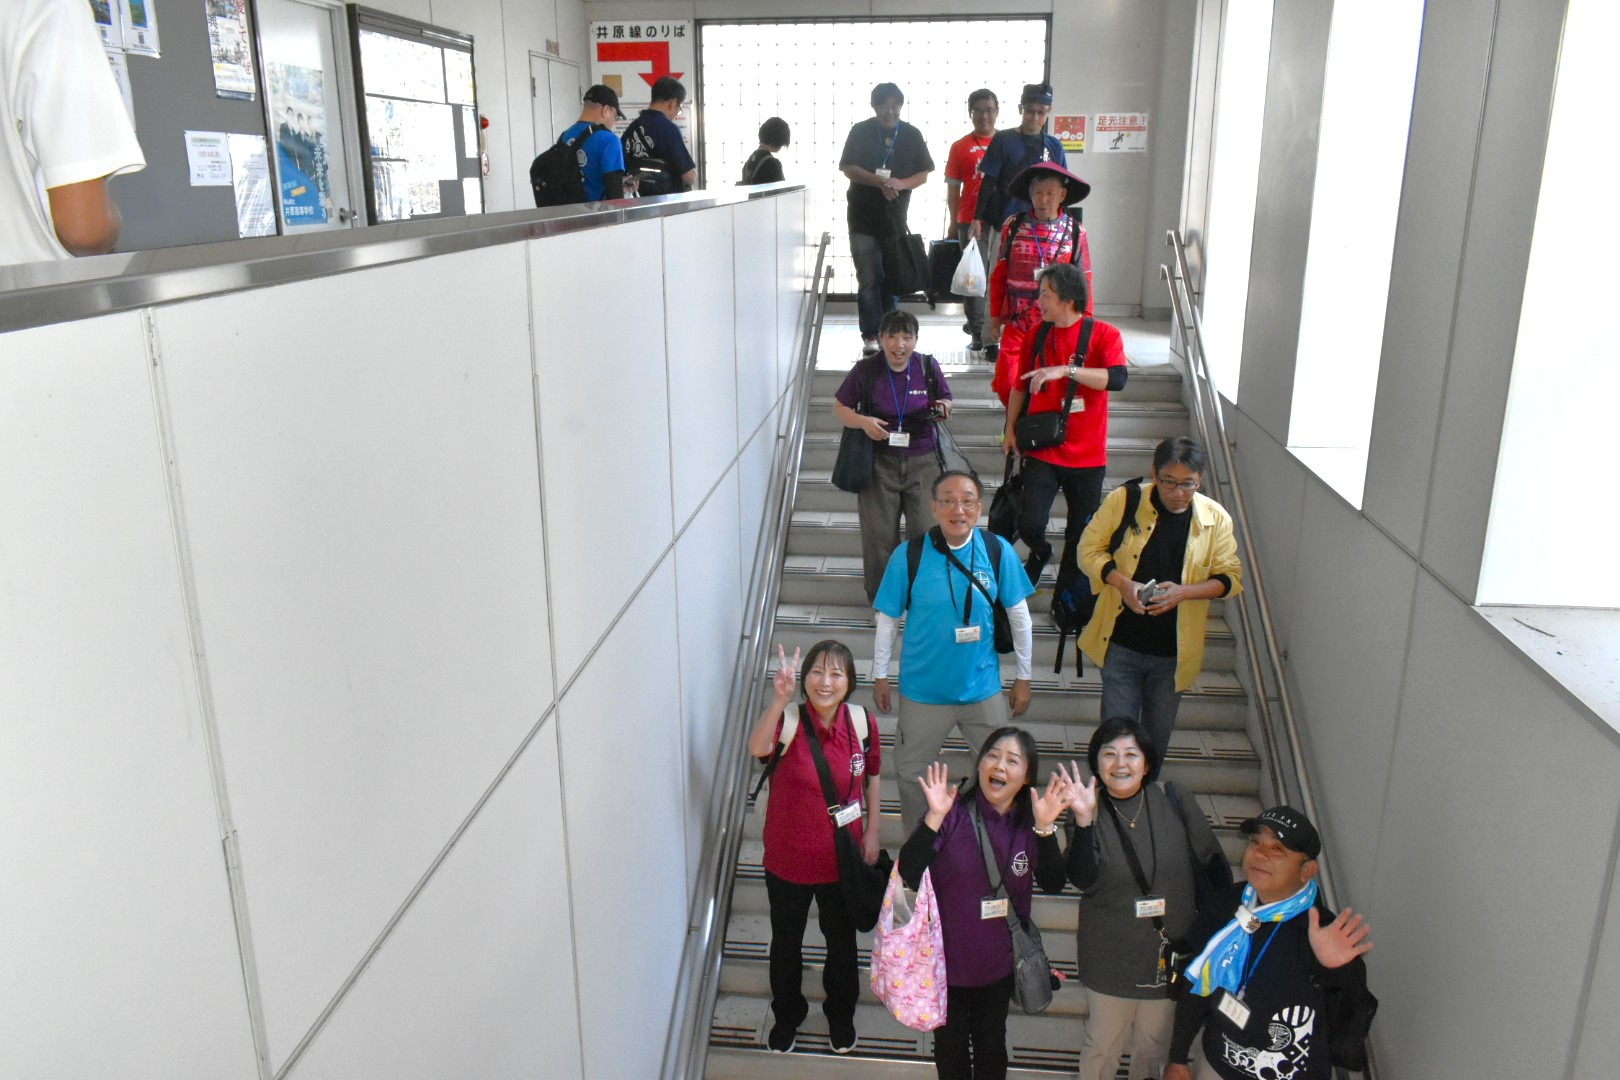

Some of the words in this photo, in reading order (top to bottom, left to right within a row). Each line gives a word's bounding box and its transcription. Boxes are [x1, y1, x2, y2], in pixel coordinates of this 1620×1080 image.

[596, 25, 686, 39] 井原線のりば
